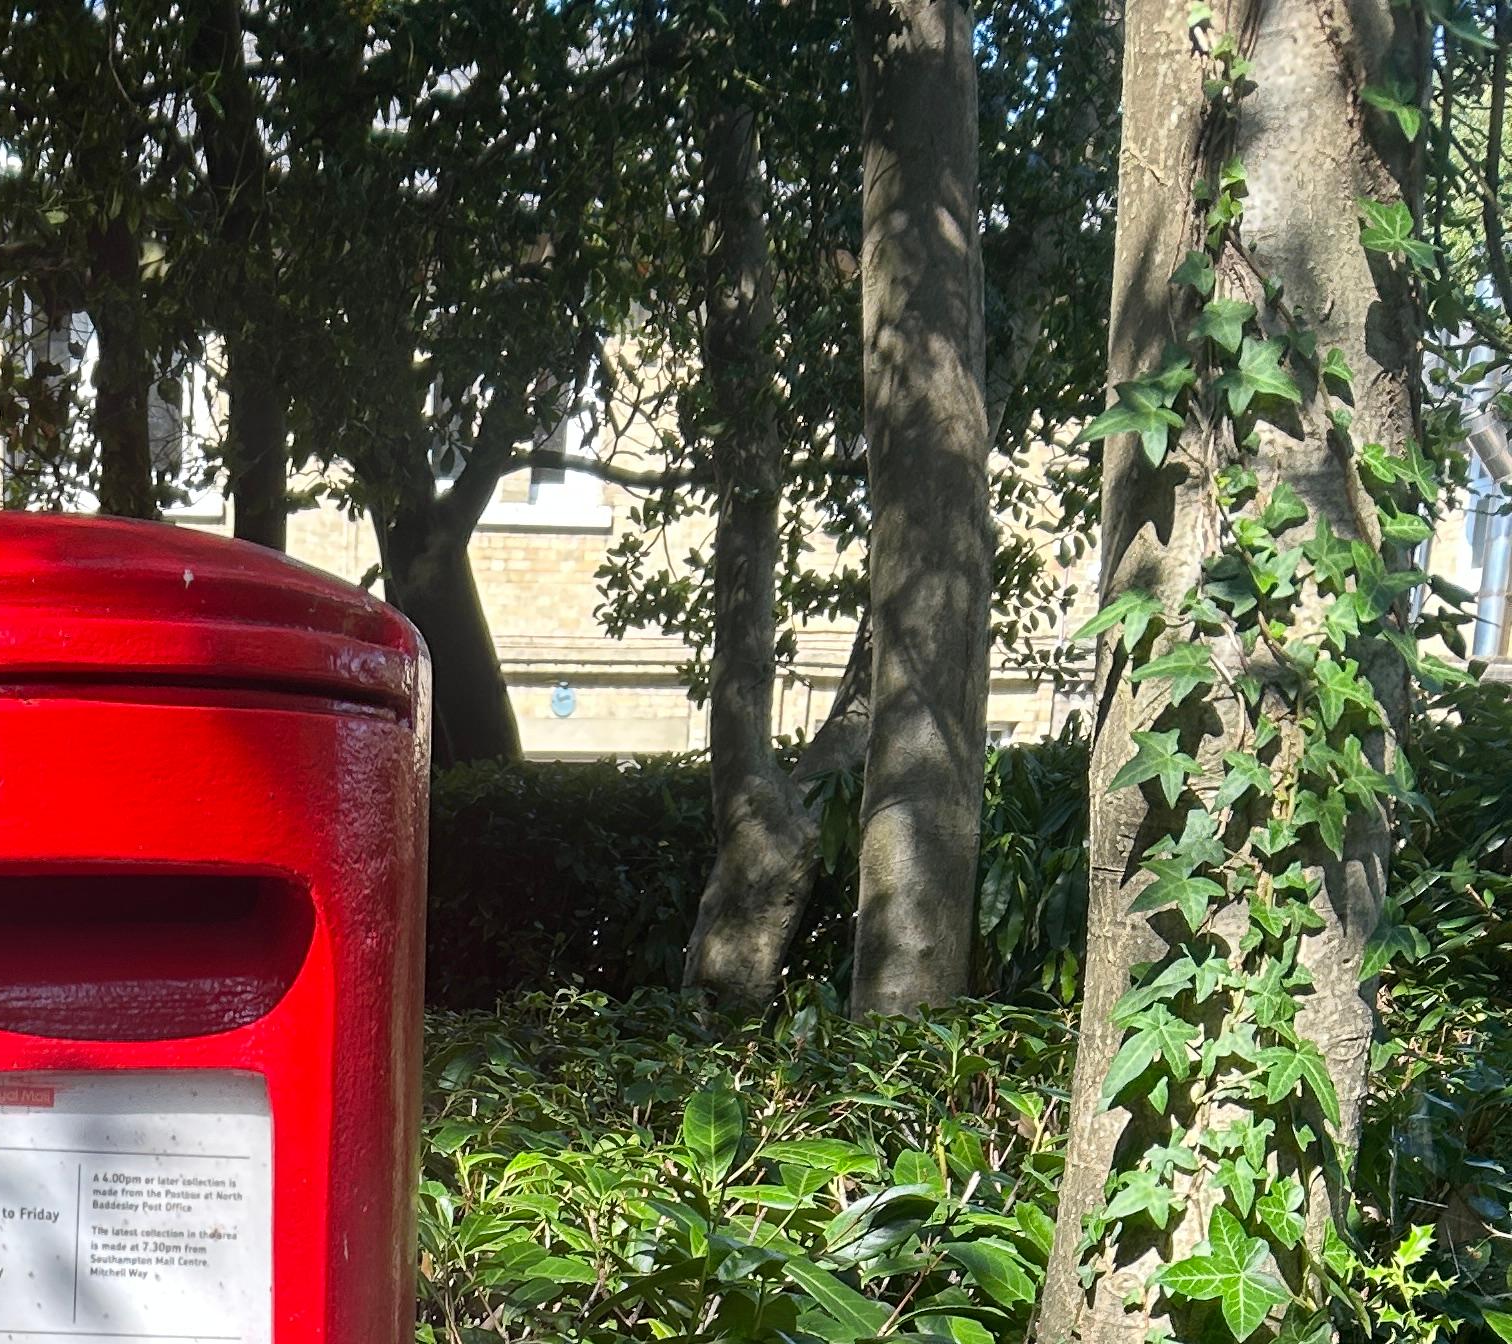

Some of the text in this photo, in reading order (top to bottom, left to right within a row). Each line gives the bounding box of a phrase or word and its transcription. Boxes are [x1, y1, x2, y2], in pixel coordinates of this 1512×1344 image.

[21, 1090, 51, 1104] Mail
[93, 1174, 99, 1182] A
[102, 1173, 141, 1185] 4.00pm
[158, 1176, 179, 1186] later
[182, 1177, 225, 1188] collection
[229, 1179, 236, 1188] is
[93, 1188, 242, 1201] made from the Postbox at North
[92, 1200, 192, 1212] Baddesley Post Office
[2, 1207, 15, 1219] to
[20, 1207, 59, 1223] Friday
[92, 1226, 109, 1236] The
[112, 1227, 138, 1237] latest
[141, 1228, 184, 1239] collection
[188, 1230, 195, 1238] in
[91, 1241, 207, 1254] is made at 7.30pm from
[90, 1254, 152, 1266] Southampton
[155, 1256, 175, 1266] Mail
[90, 1268, 148, 1279] Mitchell Way
